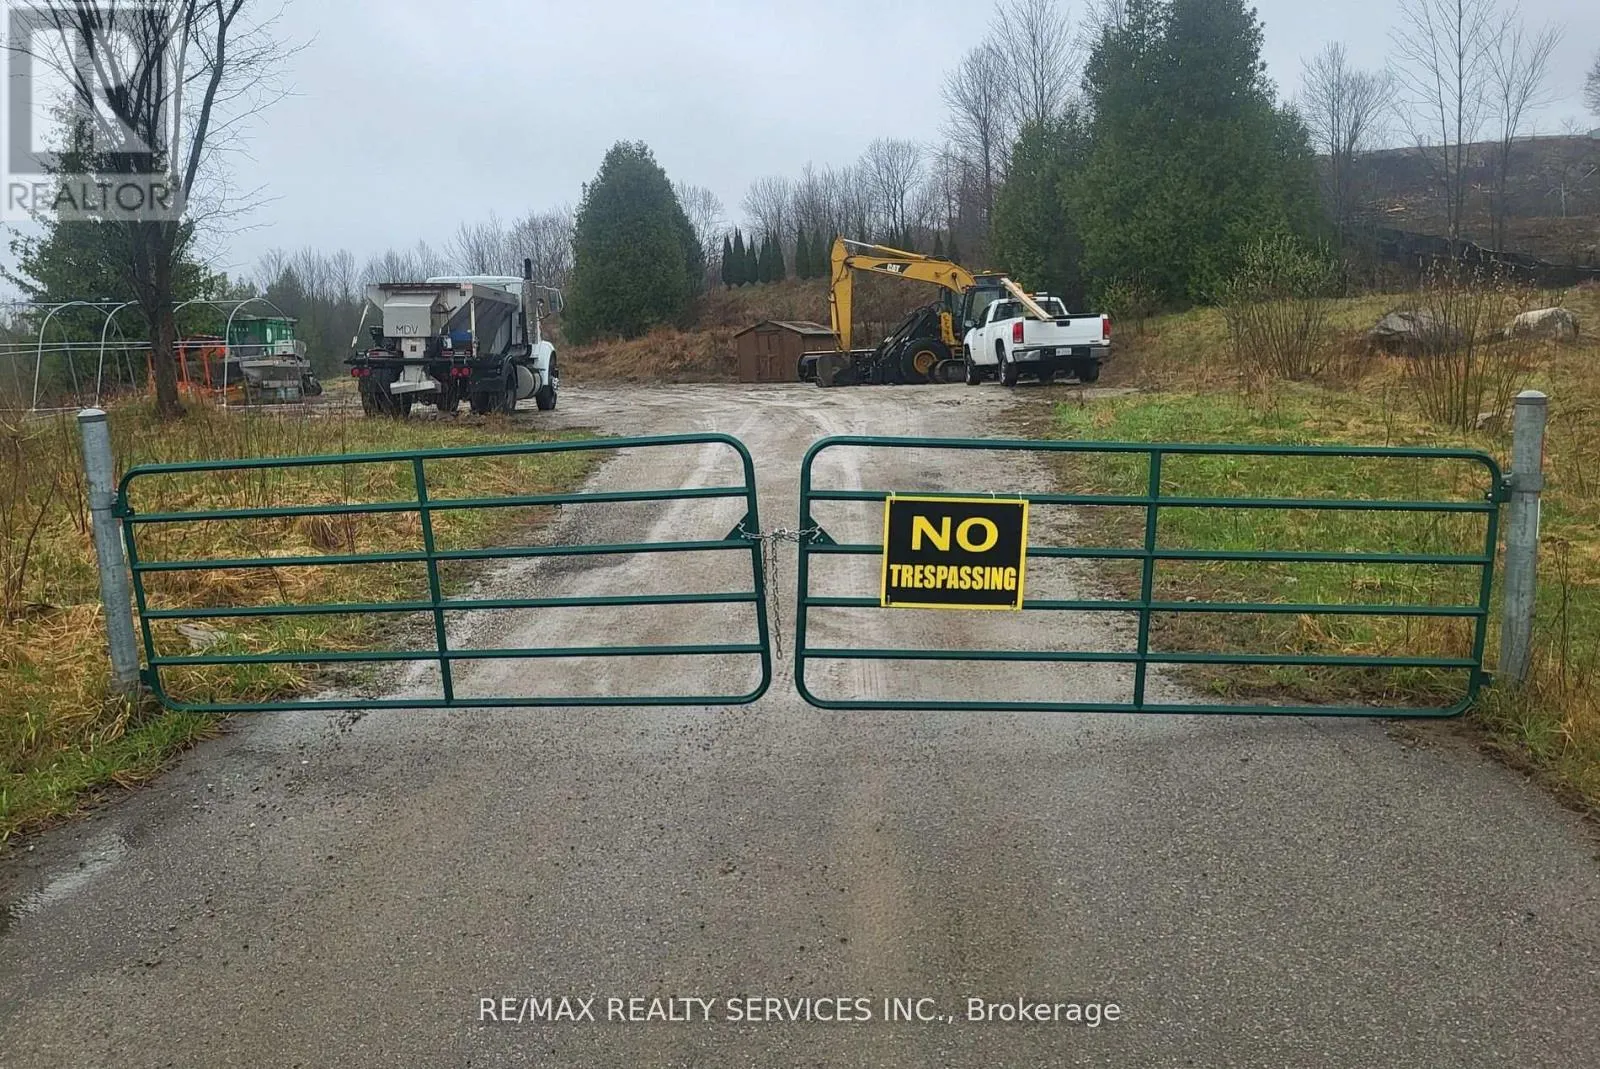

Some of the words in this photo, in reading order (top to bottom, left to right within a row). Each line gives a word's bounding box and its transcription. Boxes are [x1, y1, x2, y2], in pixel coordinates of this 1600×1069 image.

[395, 324, 419, 335] MDV
[911, 515, 999, 552] NO
[889, 564, 1016, 590] TRESPASSING
